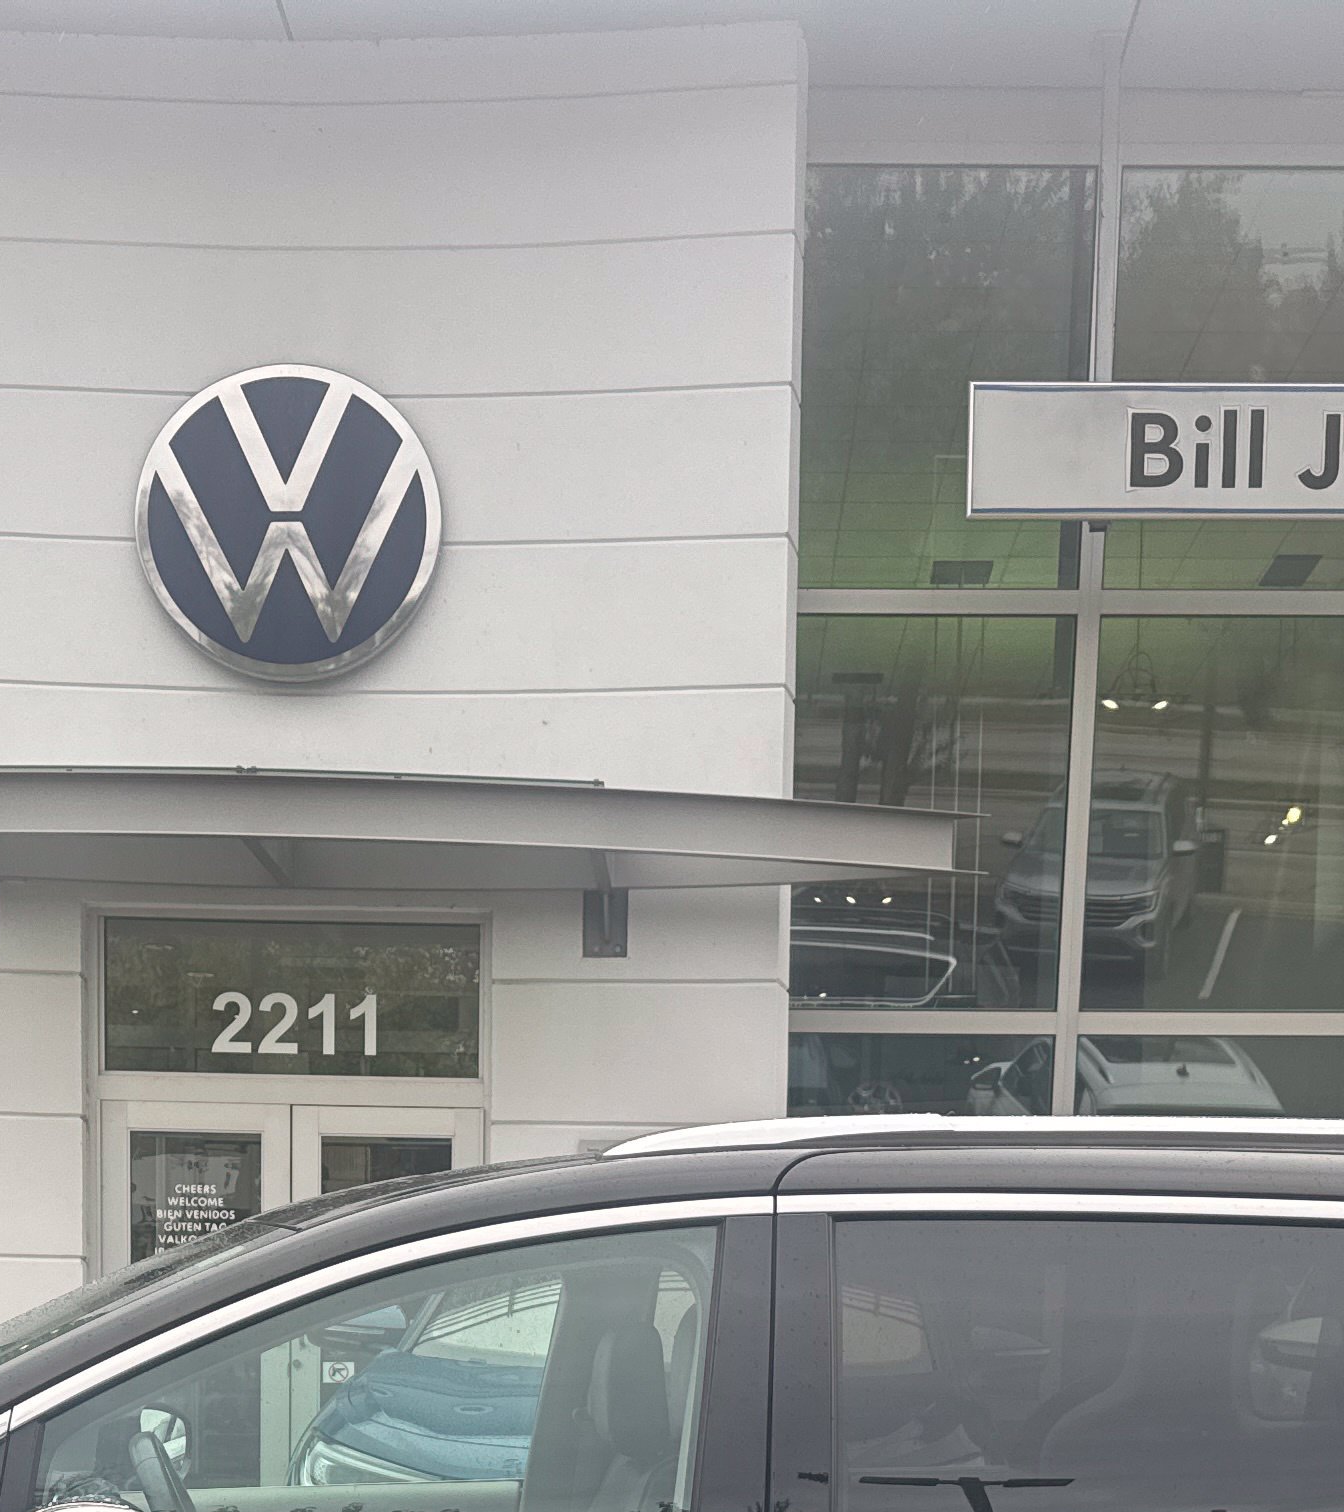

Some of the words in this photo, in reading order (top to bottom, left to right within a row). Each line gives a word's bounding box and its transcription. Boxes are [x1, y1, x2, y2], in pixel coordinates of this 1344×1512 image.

[1128, 407, 1265, 490] Bill
[144, 374, 430, 652] VW
[211, 992, 377, 1056] 2211
[174, 1184, 217, 1194] CHEERS
[167, 1197, 224, 1207] WELCOME
[156, 1209, 182, 1219] BIEN
[185, 1210, 236, 1220] VENIDOS
[164, 1222, 202, 1232] GUTEN
